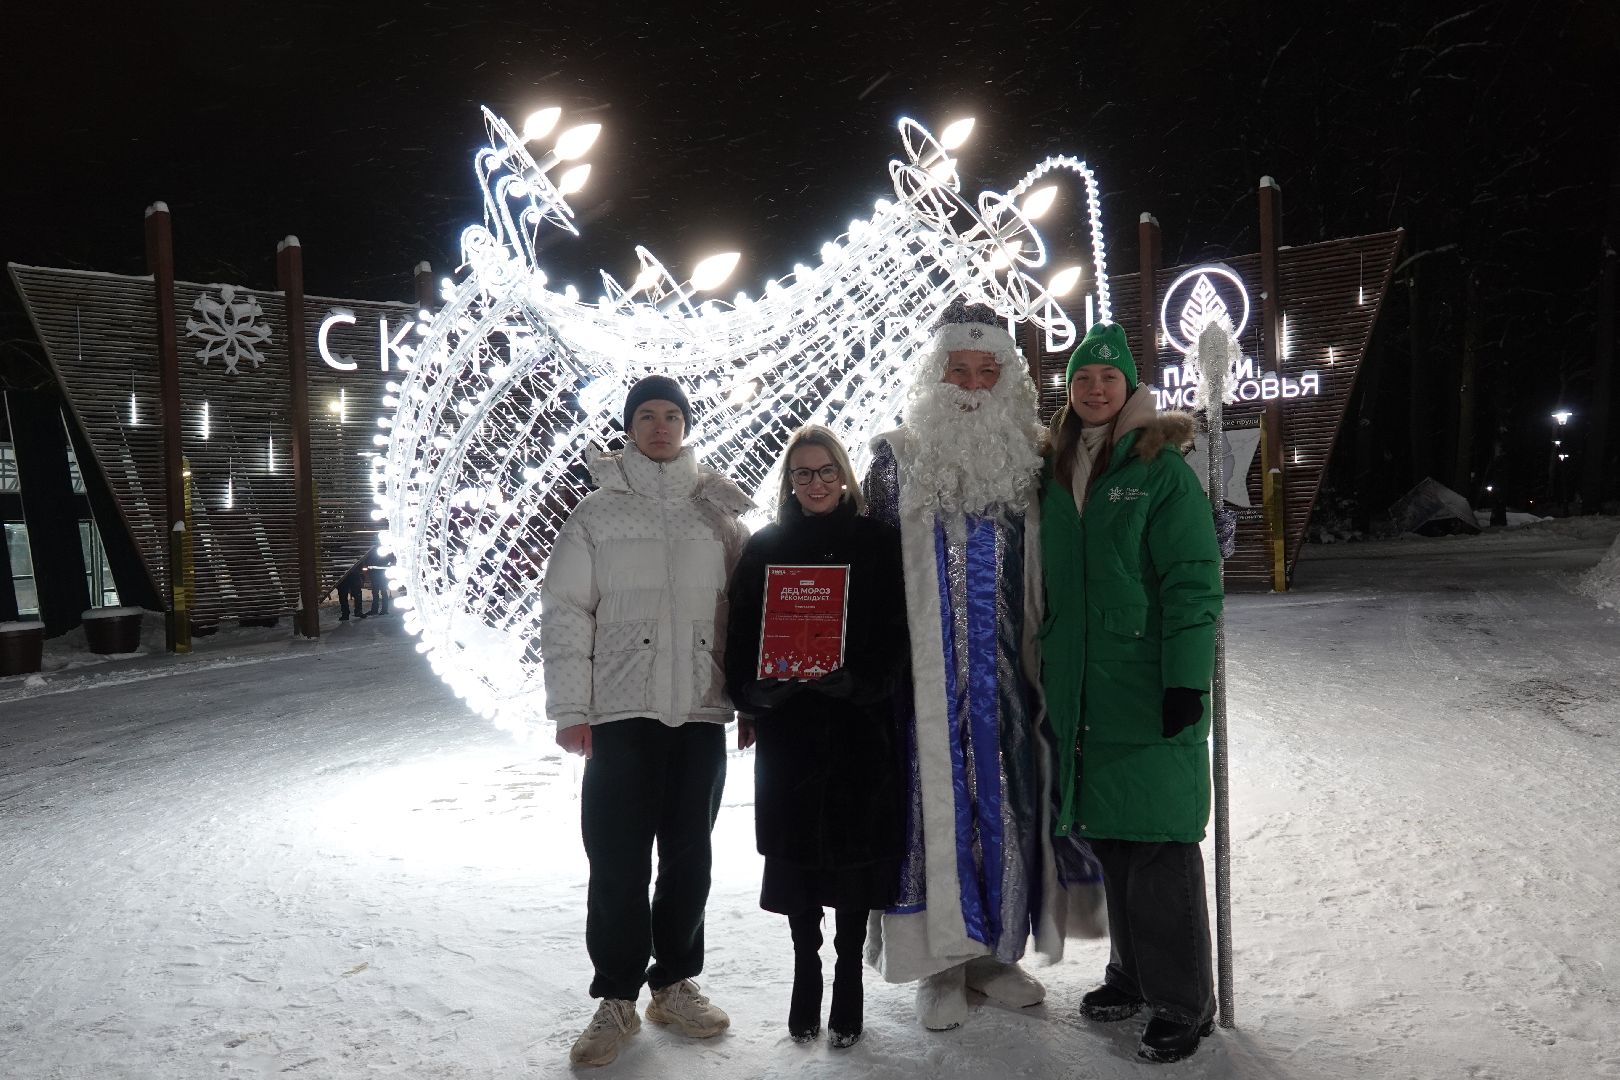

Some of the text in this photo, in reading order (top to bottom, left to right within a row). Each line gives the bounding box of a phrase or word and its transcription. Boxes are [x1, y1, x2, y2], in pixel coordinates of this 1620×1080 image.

[1163, 358, 1253, 388] ПАИ
[781, 587, 831, 595] ДЕД МОРОЗ
